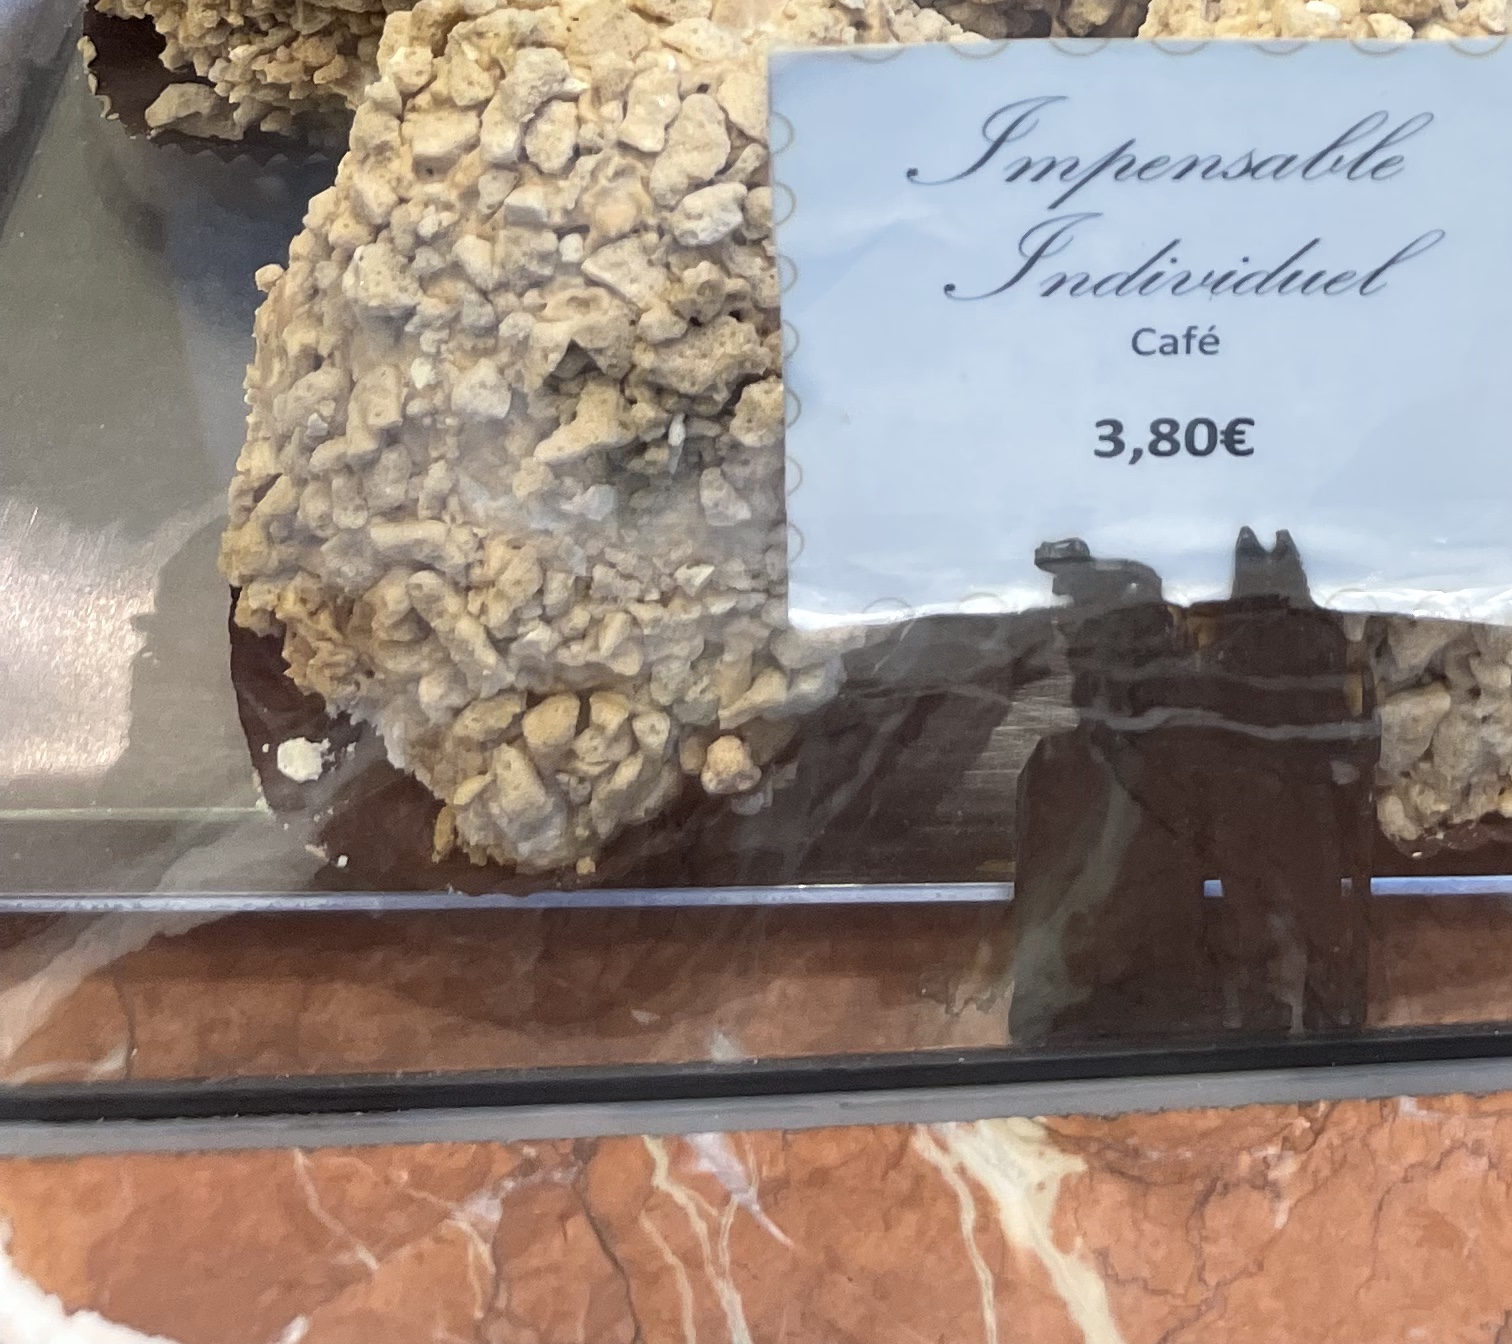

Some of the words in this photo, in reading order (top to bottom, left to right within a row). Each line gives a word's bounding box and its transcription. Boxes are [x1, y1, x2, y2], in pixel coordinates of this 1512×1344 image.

[906, 95, 1434, 209] Impensable
[943, 213, 1446, 300] Individuel
[1131, 325, 1220, 357] Café
[1093, 416, 1255, 465] 3,80€
